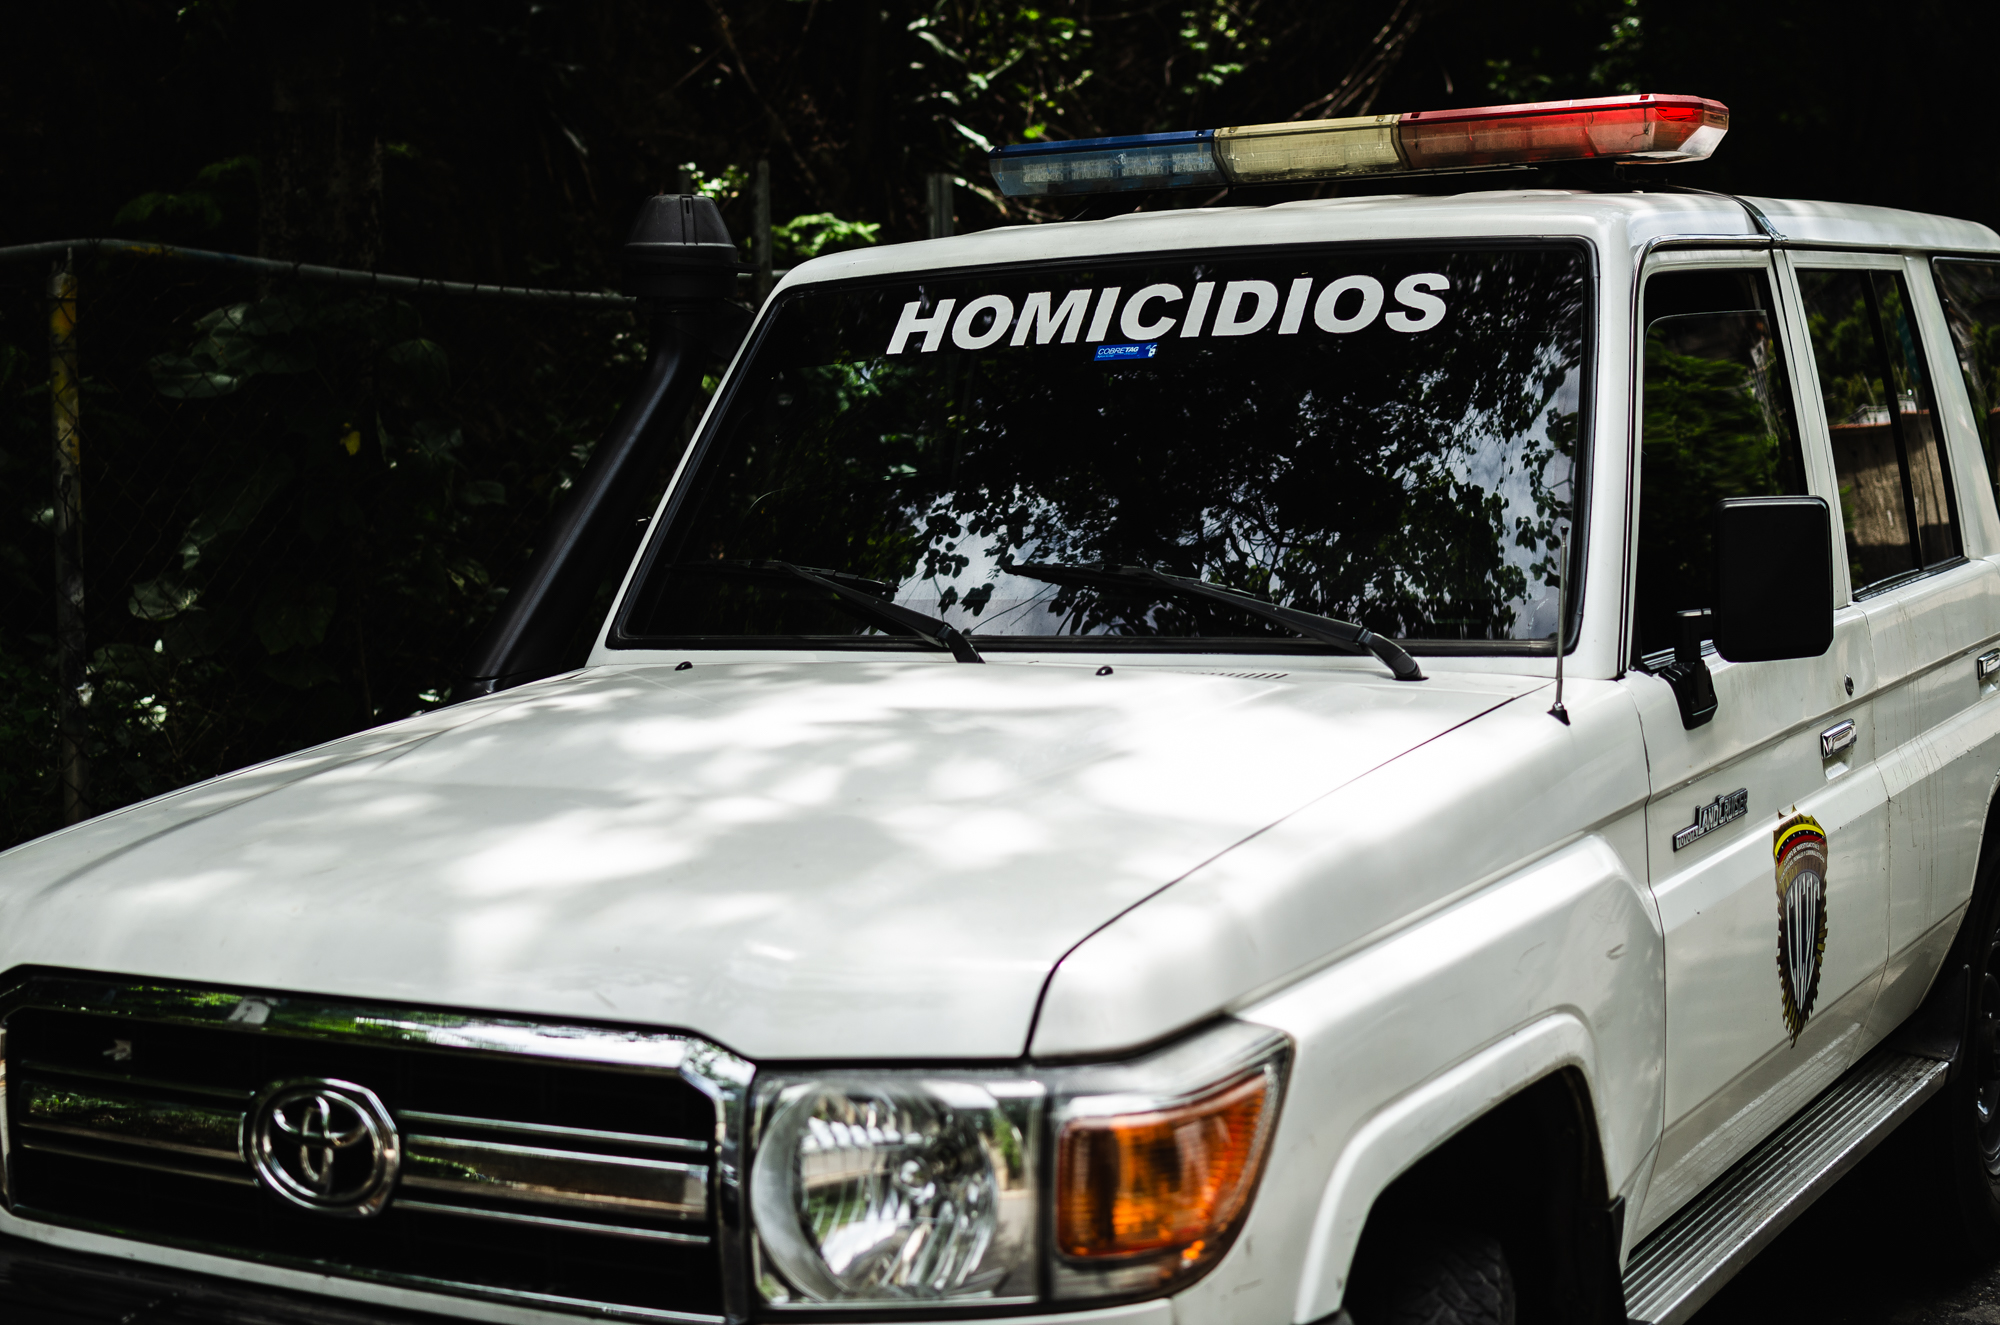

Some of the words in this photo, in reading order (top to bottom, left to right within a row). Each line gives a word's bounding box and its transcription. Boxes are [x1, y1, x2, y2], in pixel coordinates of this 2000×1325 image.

[886, 272, 1450, 354] HOMICIDIOS
[1097, 346, 1140, 356] COBRETAG
[1676, 826, 1699, 849] TOYOTA
